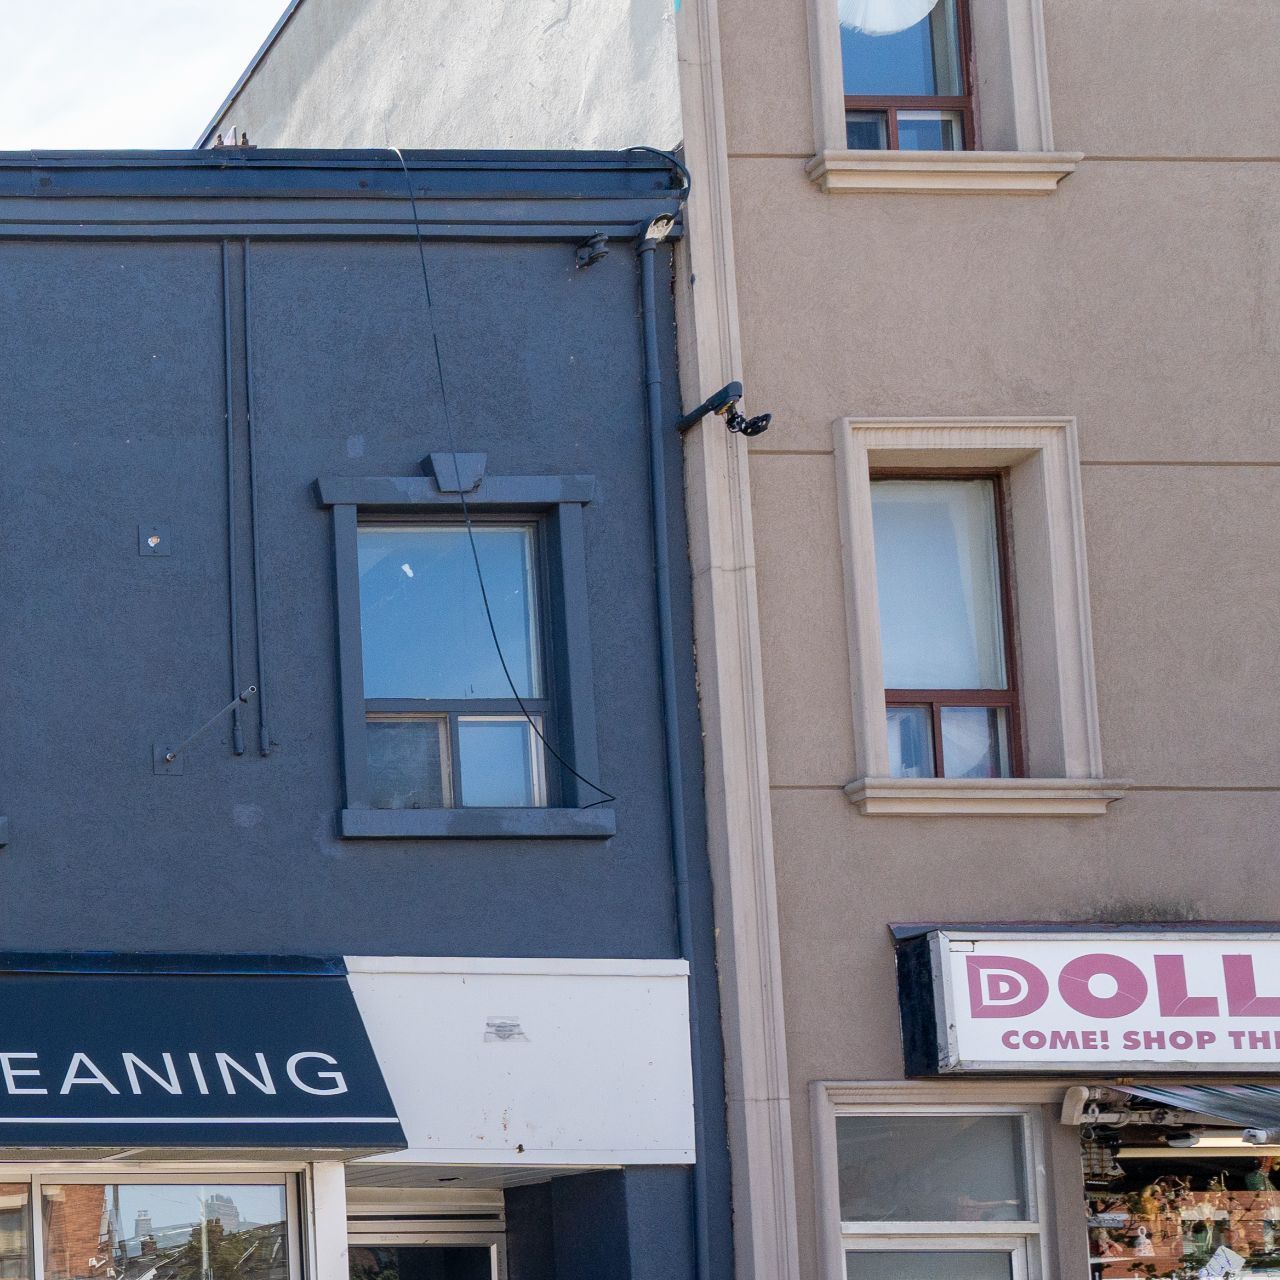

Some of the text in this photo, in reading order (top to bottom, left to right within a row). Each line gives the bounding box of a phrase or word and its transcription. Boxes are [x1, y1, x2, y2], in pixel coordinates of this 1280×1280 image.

[1001, 1030, 1280, 1050] COME! SHOP TH
